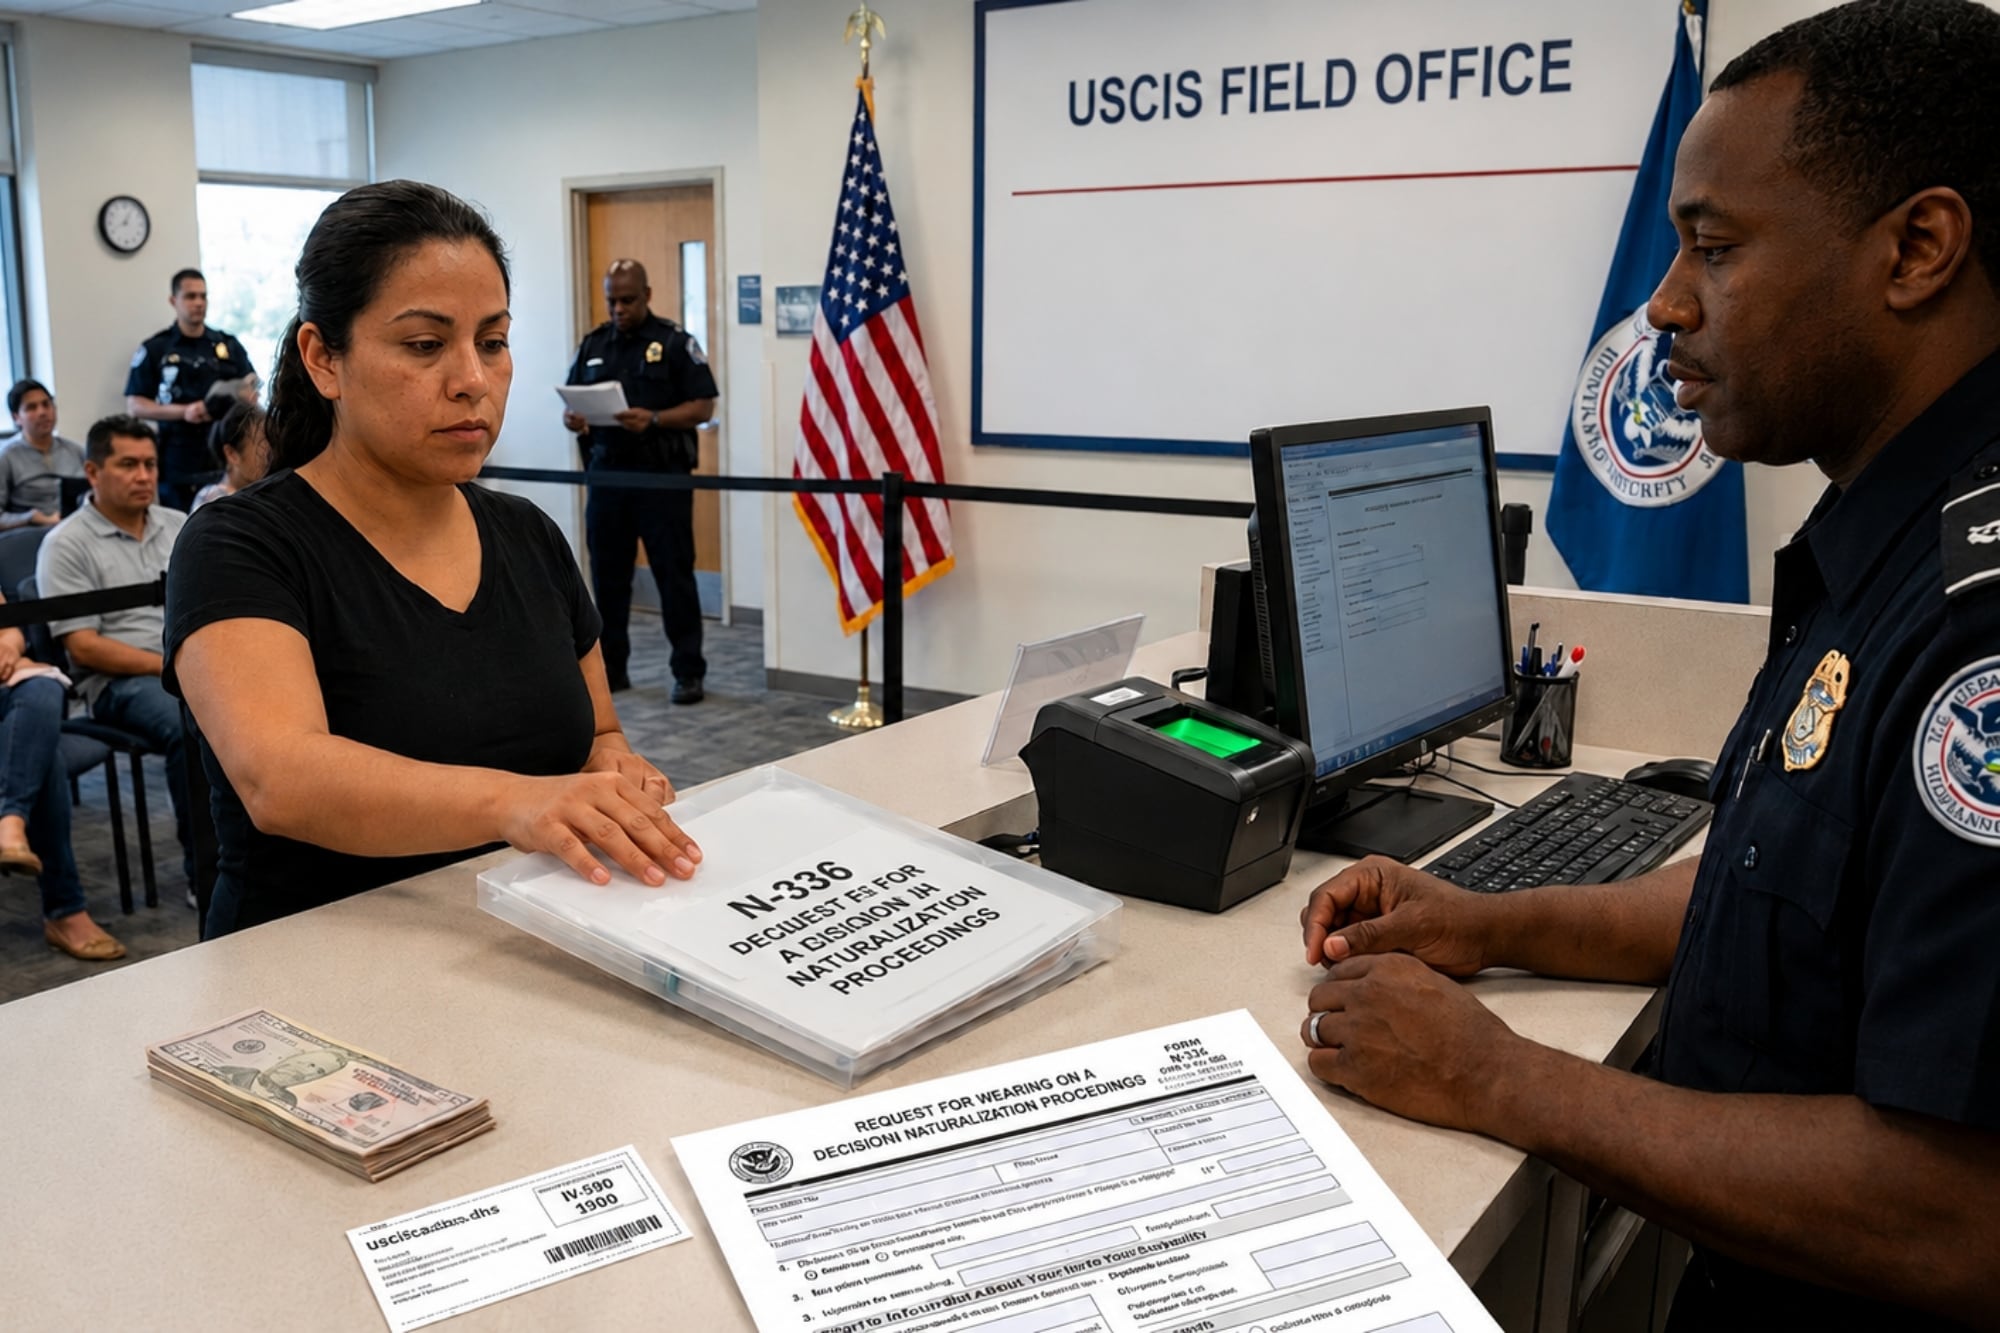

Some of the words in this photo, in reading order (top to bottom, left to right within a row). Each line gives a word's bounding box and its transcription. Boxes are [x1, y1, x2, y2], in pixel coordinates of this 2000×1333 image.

[1068, 69, 1203, 126] USCIS
[1220, 58, 1357, 115] FIELD
[1375, 39, 1573, 104] OFFICE
[727, 861, 853, 920] N-336
[871, 864, 926, 890] FOR
[779, 949, 804, 964] A
[829, 907, 1001, 995] PROCEEDINGS
[854, 1107, 935, 1133] REQUEST
[938, 1094, 976, 1113] FOR
[977, 1078, 1054, 1104] WEARING
[1056, 1072, 1083, 1086] ON
[1083, 1068, 1097, 1081] A
[905, 1101, 1039, 1140] NATURALIZATION
[1040, 1073, 1148, 1109] PROCEDINGS
[575, 1193, 619, 1214] 1900
